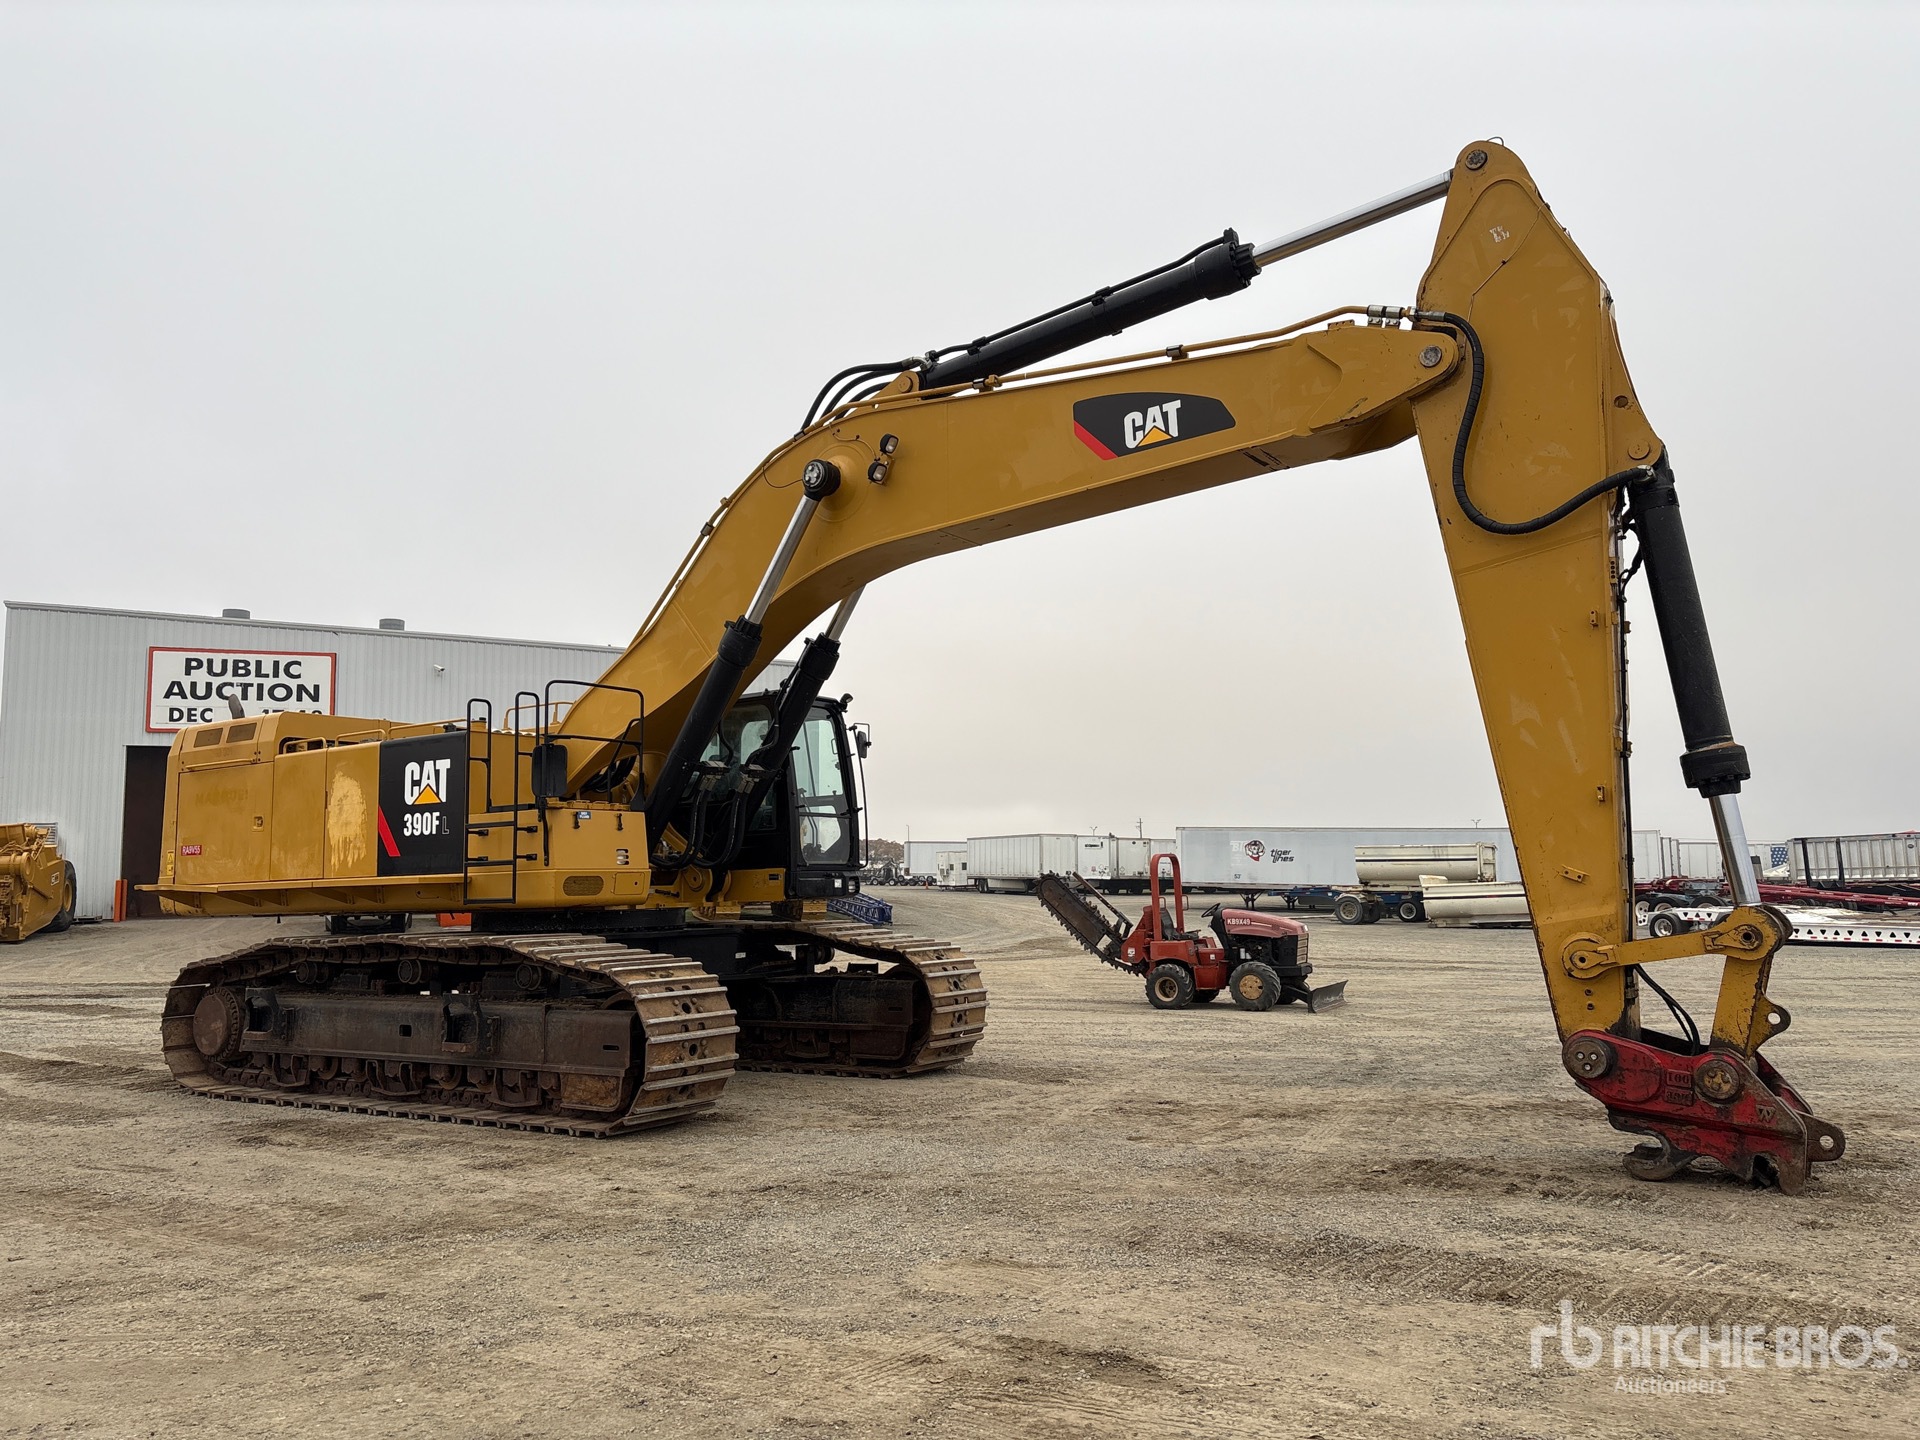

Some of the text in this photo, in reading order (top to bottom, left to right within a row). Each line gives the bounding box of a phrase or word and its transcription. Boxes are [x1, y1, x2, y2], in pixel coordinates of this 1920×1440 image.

[1124, 399, 1181, 449] CAT
[184, 657, 302, 679] PUBLIC
[163, 680, 320, 702] AUCTION
[168, 707, 213, 722] DEC
[404, 759, 451, 806] CAT
[403, 812, 450, 836] 390F L
[1270, 849, 1291, 857] tiger
